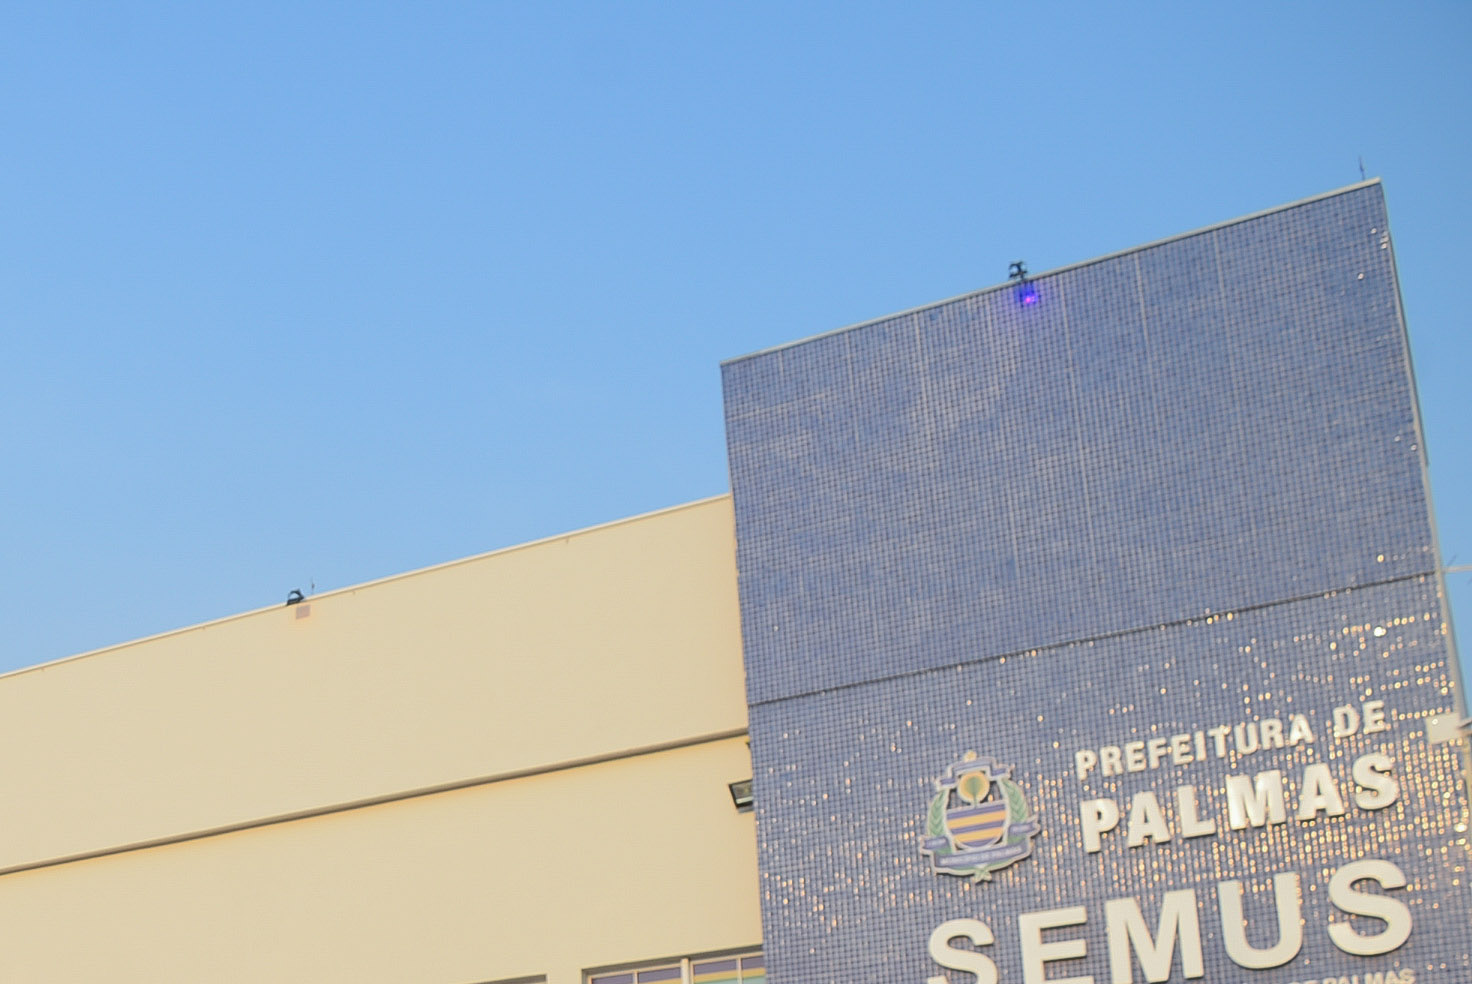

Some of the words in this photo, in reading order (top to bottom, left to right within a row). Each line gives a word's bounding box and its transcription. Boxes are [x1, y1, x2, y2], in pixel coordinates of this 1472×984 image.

[1074, 714, 1314, 780] PREFEITURA
[1332, 699, 1387, 738] DE
[1079, 752, 1401, 854] PALMAS
